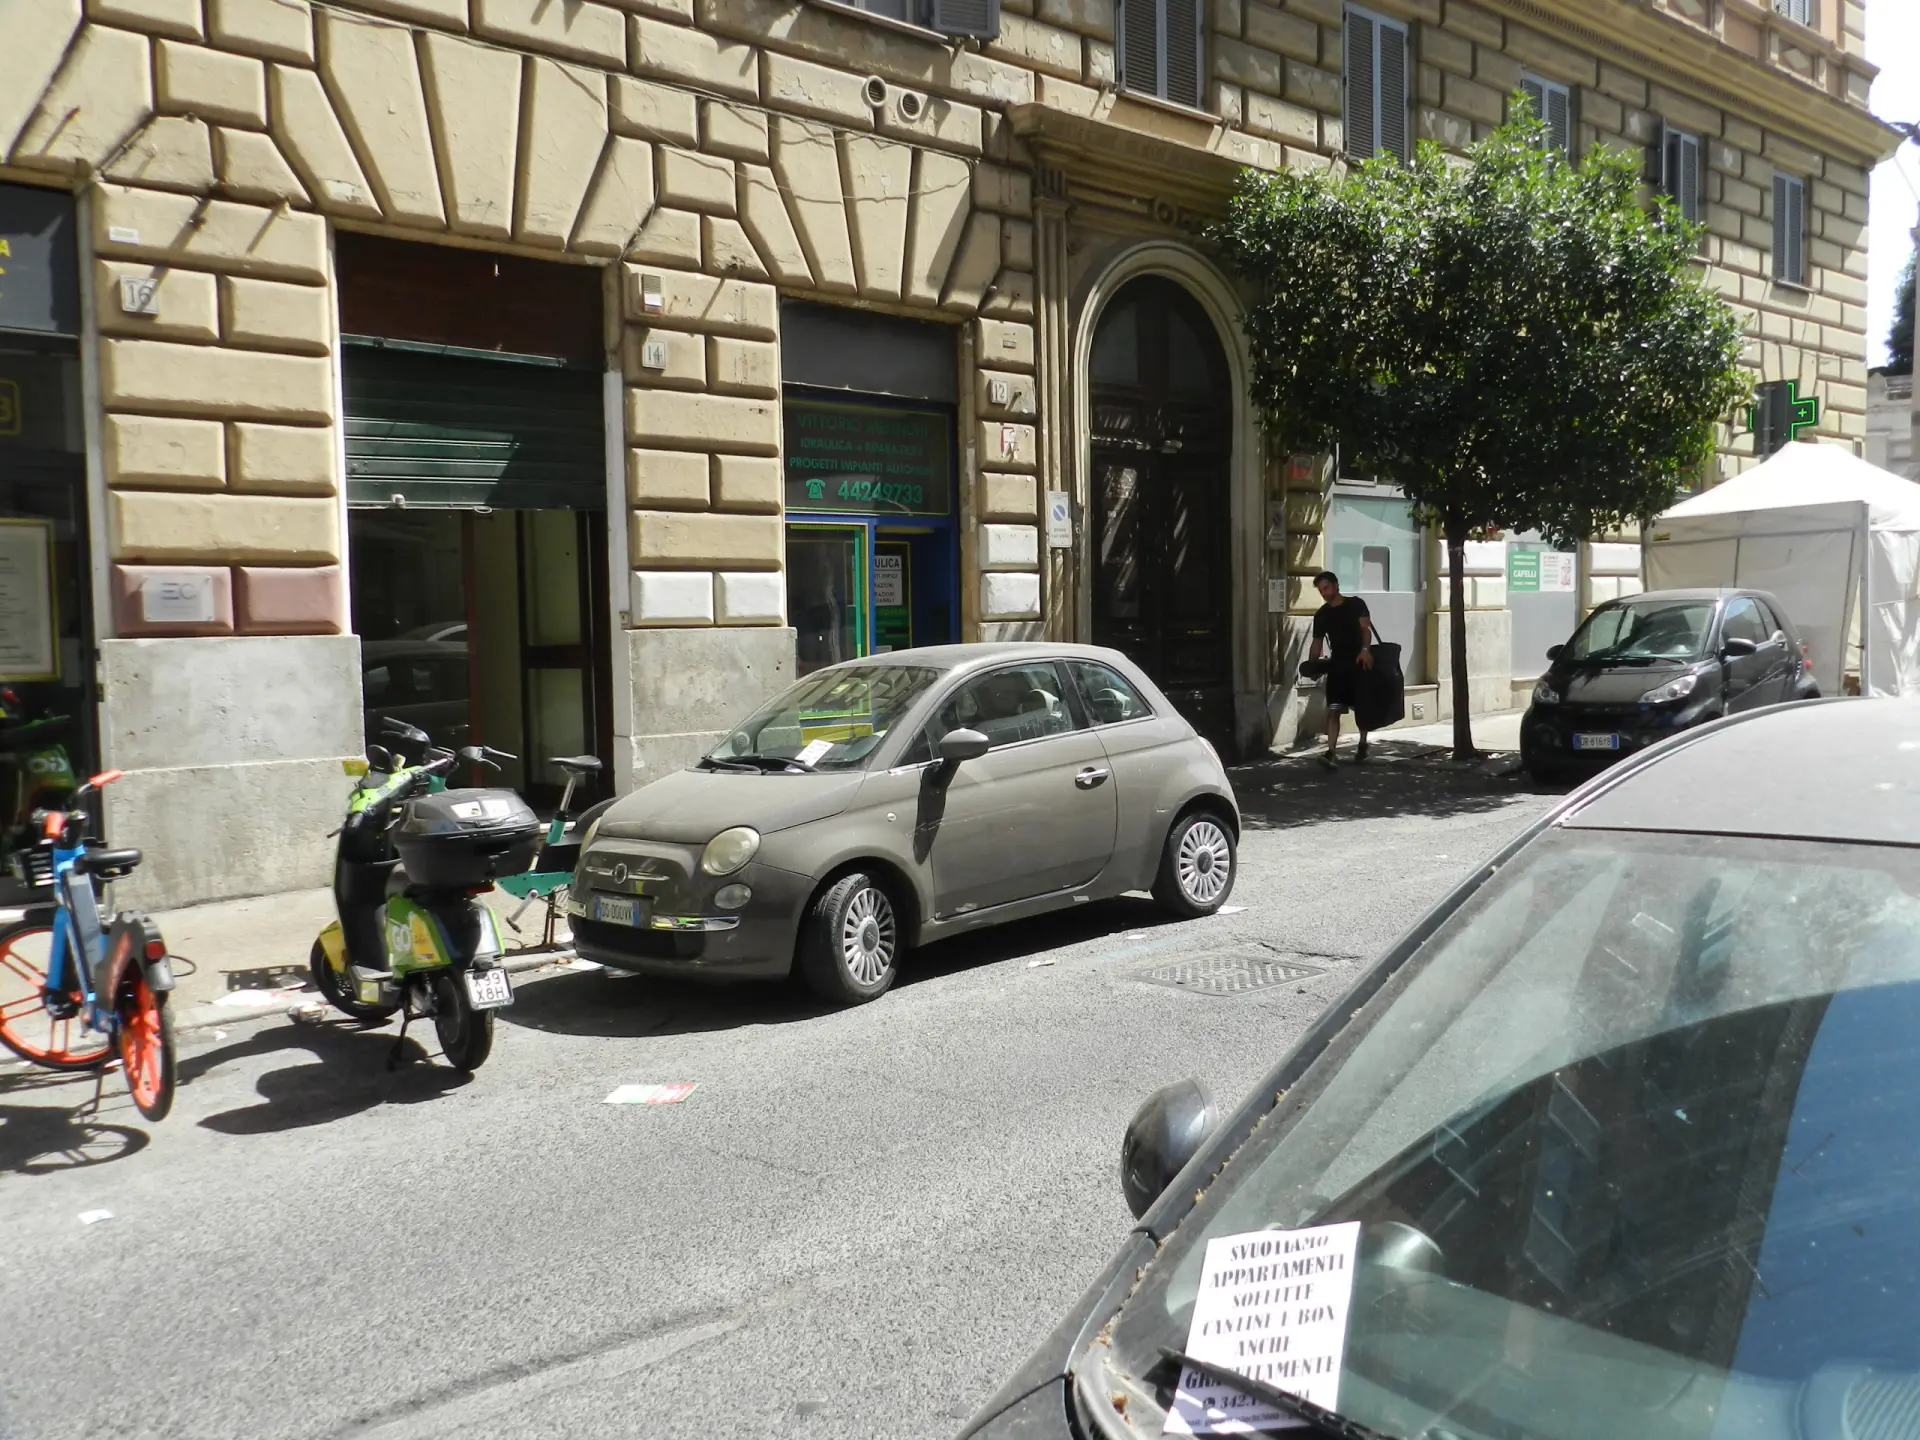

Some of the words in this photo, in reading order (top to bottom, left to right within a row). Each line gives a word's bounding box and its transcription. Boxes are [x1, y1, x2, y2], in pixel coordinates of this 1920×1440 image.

[128, 284, 153, 306] 16
[647, 345, 662, 362] 14
[993, 383, 1005, 400] 12
[800, 437, 852, 450] IDRAULICA
[789, 456, 837, 470] PROGETTI
[840, 459, 882, 473] IMPIANTI
[838, 480, 923, 504] 44249733
[875, 558, 900, 569] ULICA
[476, 986, 505, 1001] X8H
[1230, 1235, 1329, 1262] SVUOTIAMO
[1209, 1253, 1344, 1288] APPARTAMENTI
[1298, 1304, 1335, 1326] BOX
